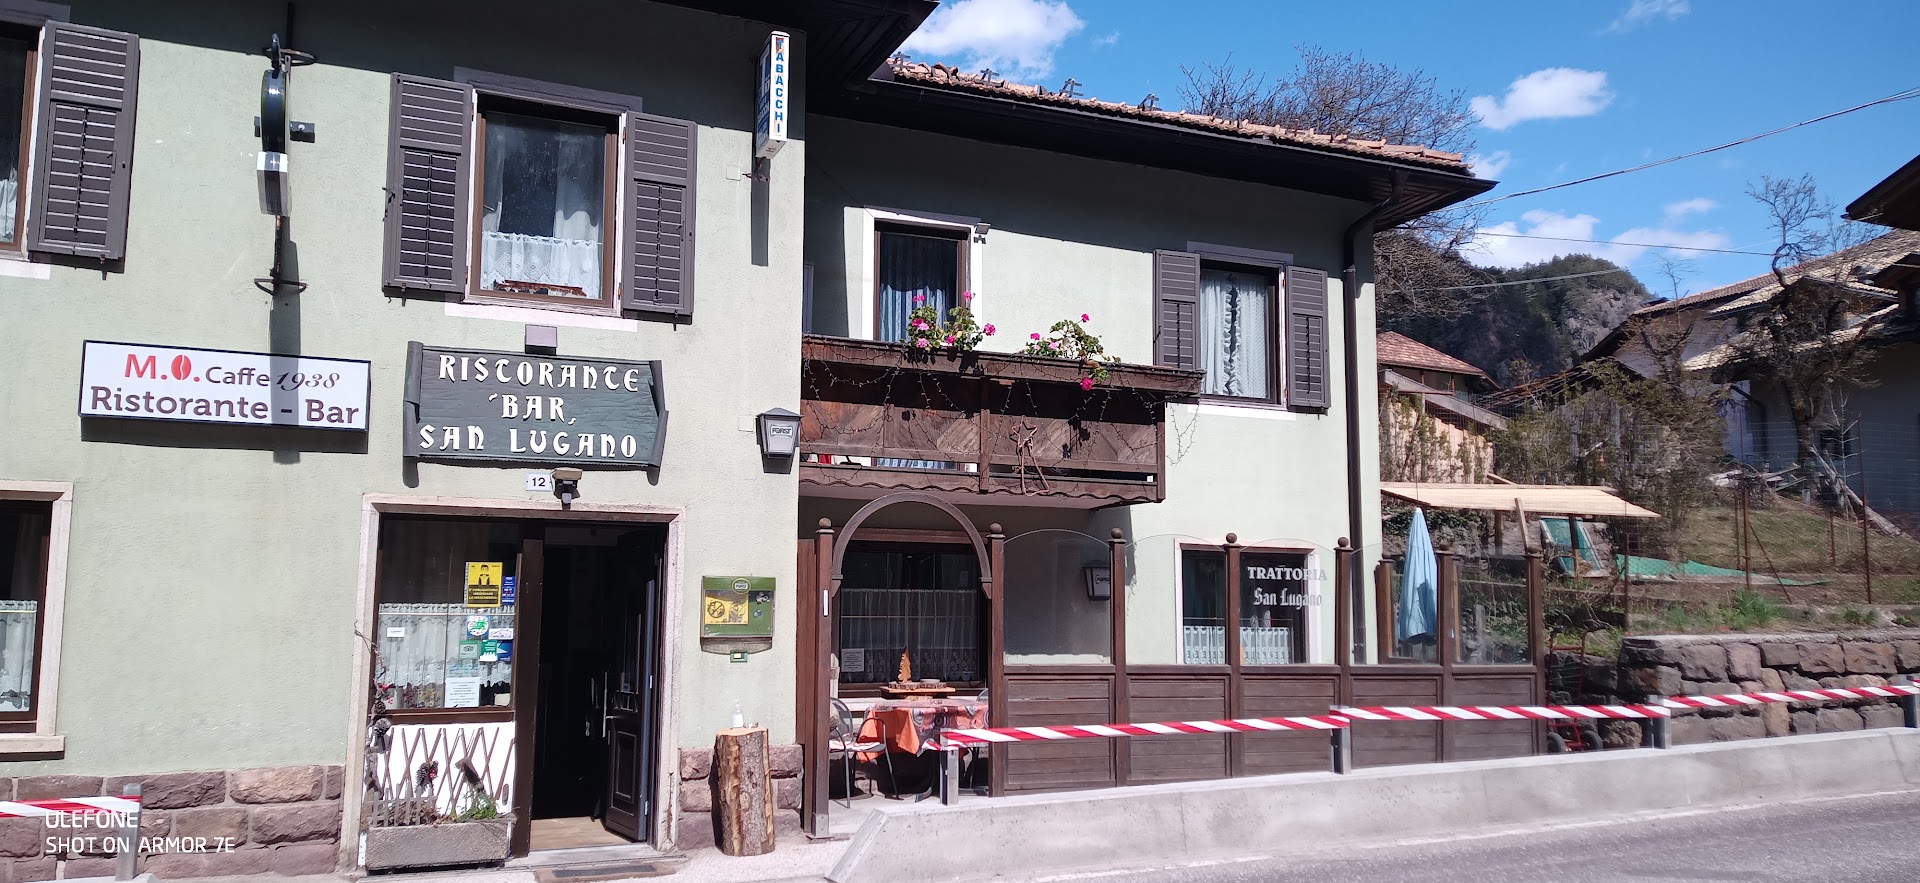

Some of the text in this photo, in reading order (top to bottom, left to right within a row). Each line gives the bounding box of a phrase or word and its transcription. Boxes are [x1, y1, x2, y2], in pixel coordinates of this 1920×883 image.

[774, 39, 785, 133] TABACCHI
[205, 366, 271, 387] Caffe
[275, 371, 340, 391] 1938
[438, 354, 640, 392] RISTORANTE
[90, 385, 269, 420] Ristorante
[305, 398, 360, 424] Bar
[419, 424, 638, 458] SAN LUGANO
[531, 477, 546, 487] 12
[1247, 566, 1328, 581] TRATTORIA
[1253, 587, 1323, 611] San Lugano
